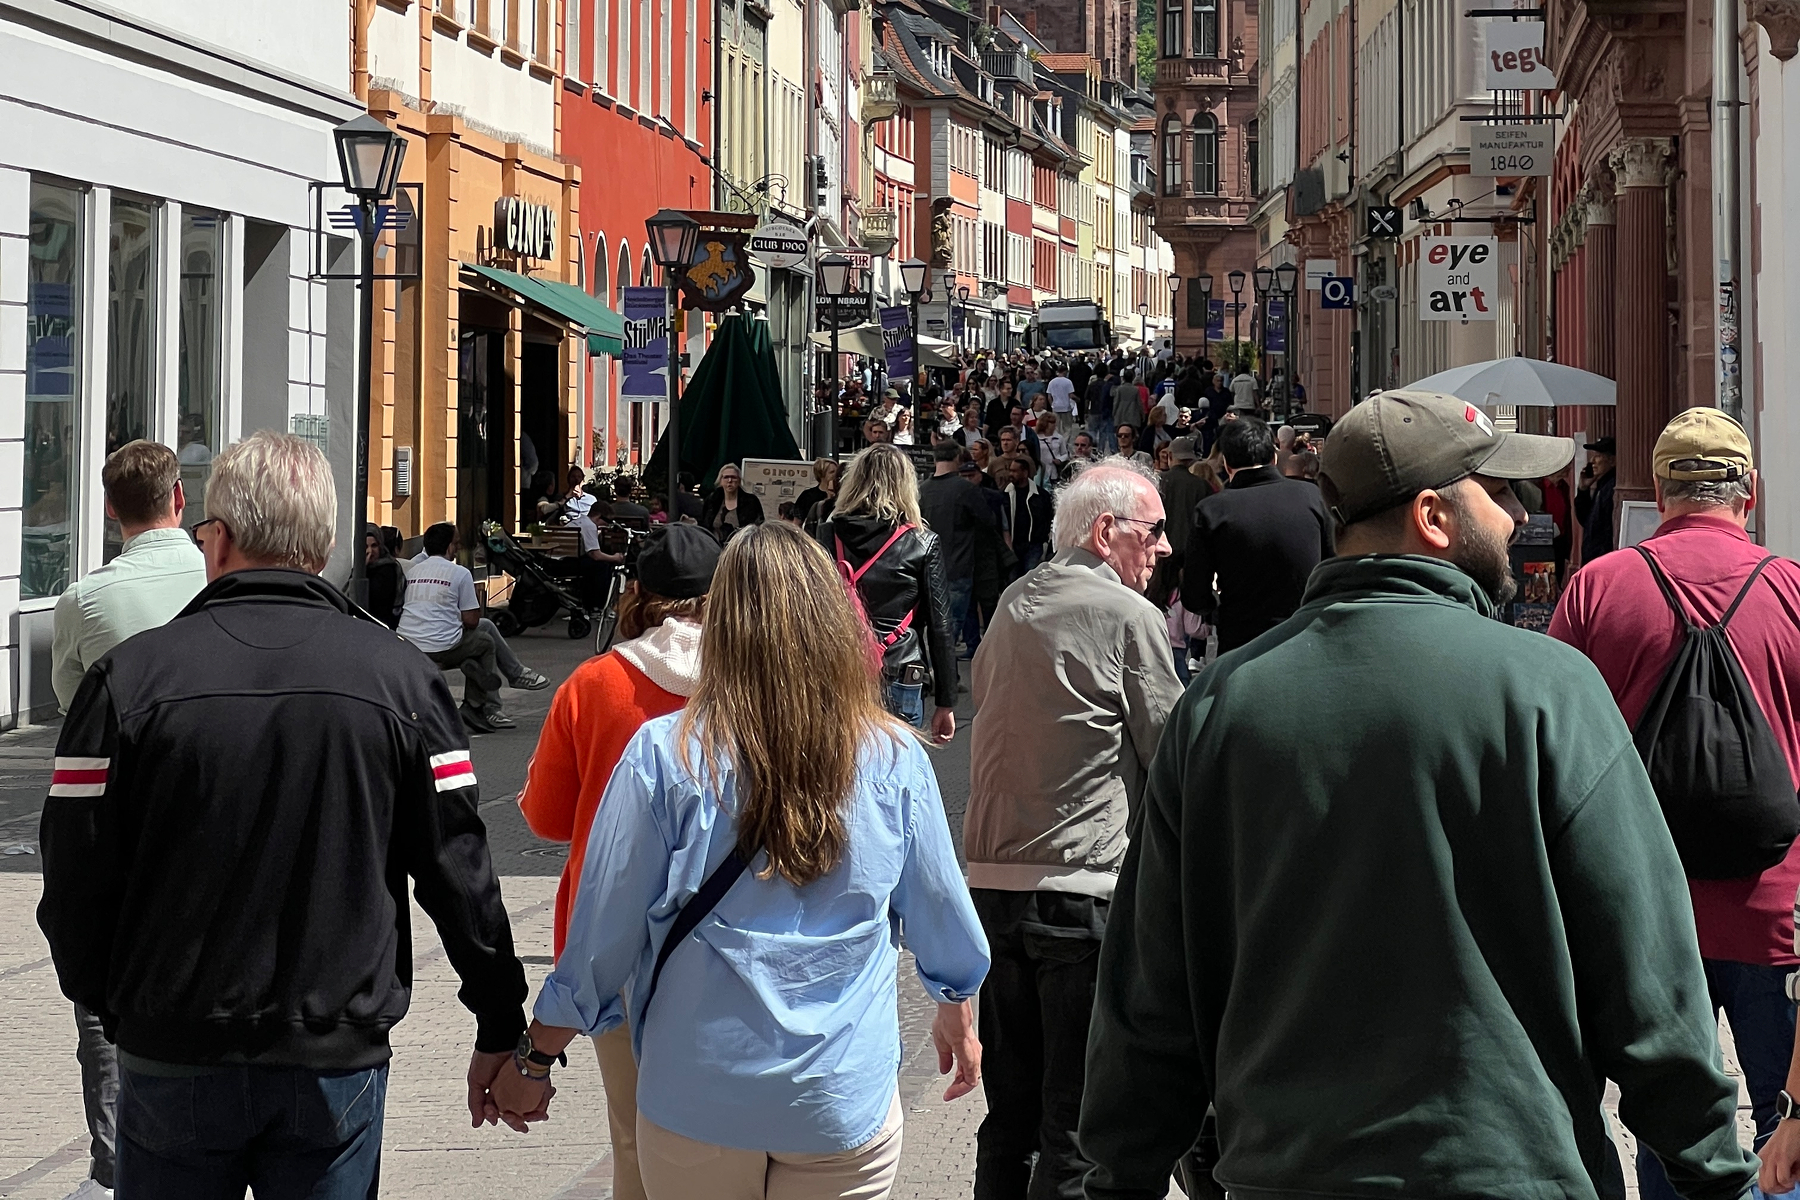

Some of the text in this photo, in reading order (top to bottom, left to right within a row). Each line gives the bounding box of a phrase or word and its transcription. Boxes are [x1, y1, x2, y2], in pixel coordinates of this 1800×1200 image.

[1495, 131, 1527, 139] SEIFEN
[1480, 141, 1544, 149] MANUFAKTUR
[507, 197, 557, 261] GINO'S
[753, 240, 805, 252] CLUB 1900
[1428, 244, 1489, 271] eye
[1447, 272, 1470, 285] and
[1430, 286, 1488, 312] art
[762, 468, 808, 478] GINO'S
